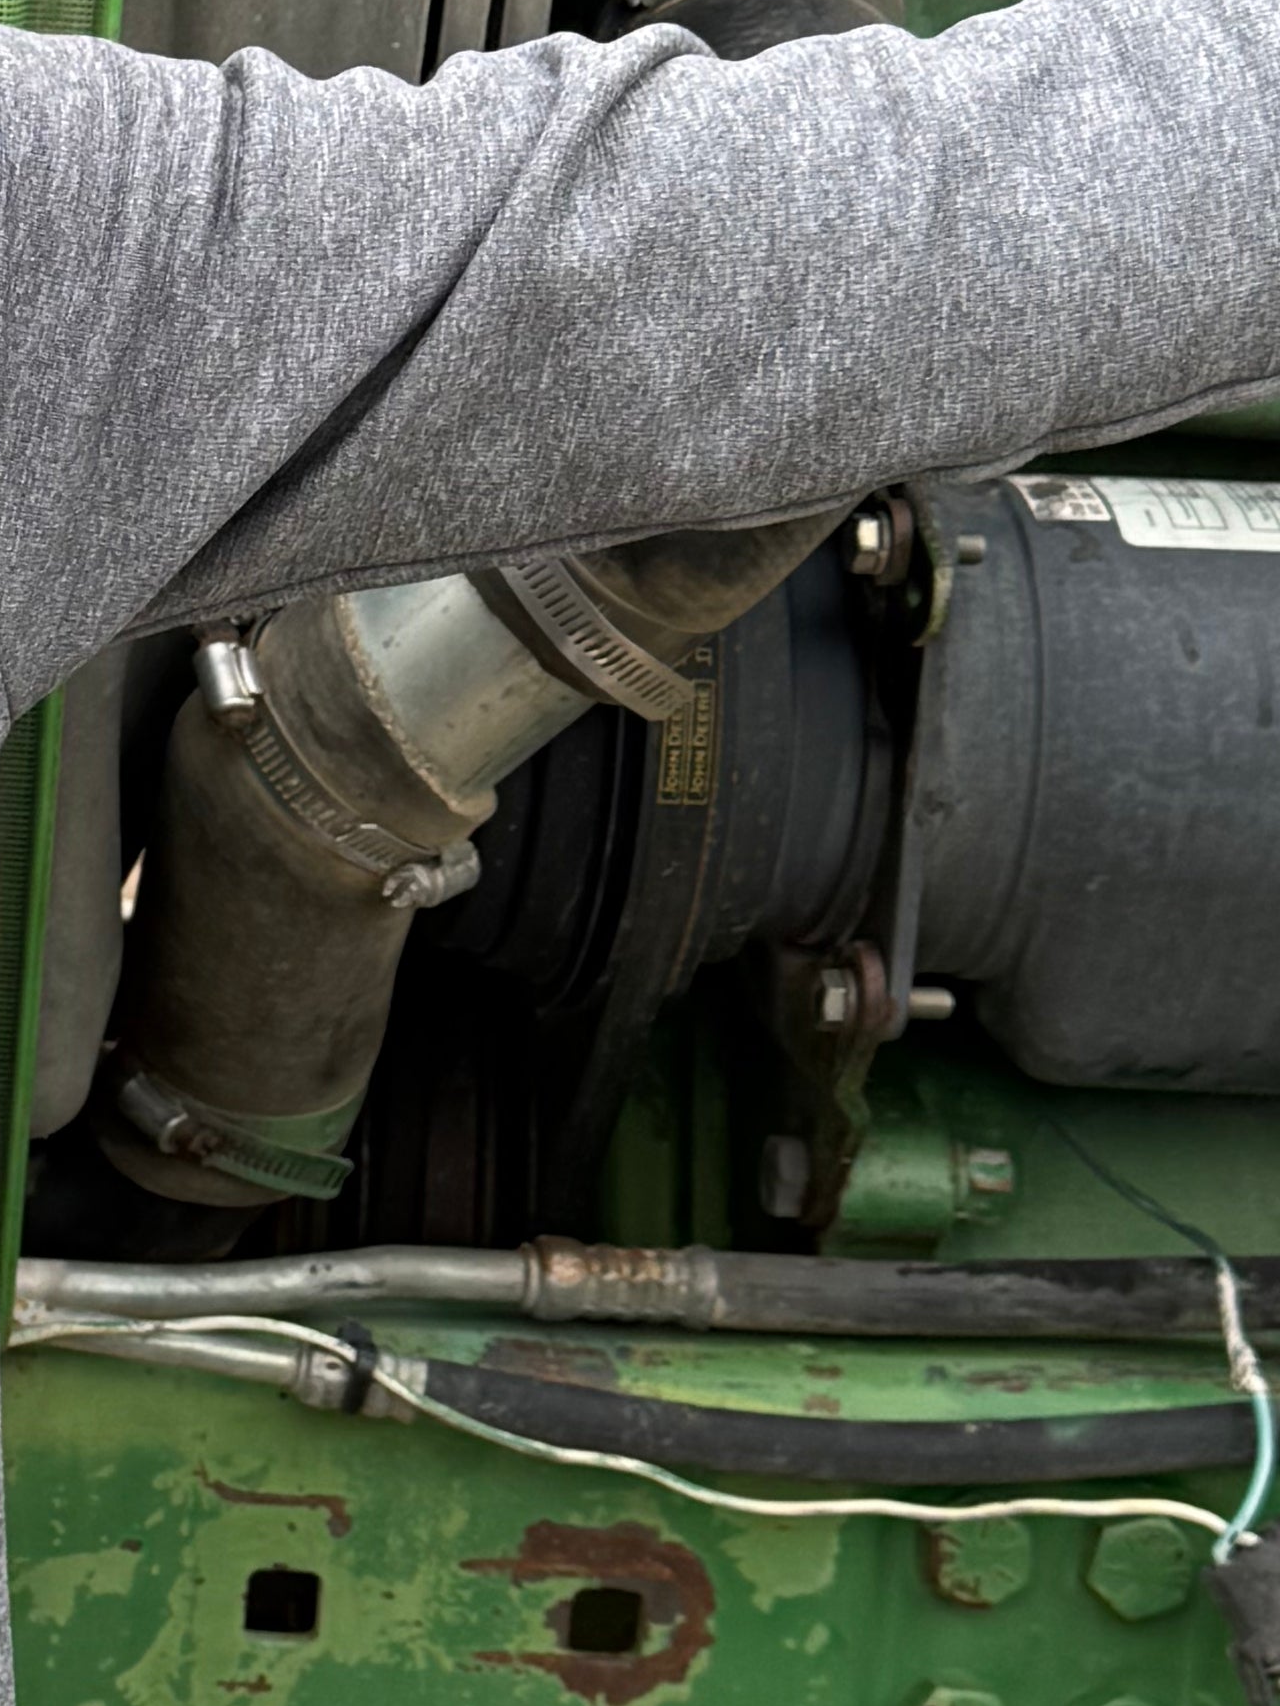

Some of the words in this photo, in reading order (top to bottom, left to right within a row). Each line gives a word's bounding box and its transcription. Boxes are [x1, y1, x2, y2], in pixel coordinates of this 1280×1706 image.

[668, 709, 683, 747] DEE
[693, 688, 711, 747] DEERE
[665, 750, 681, 793] JOHN
[691, 750, 707, 793] JOHN
